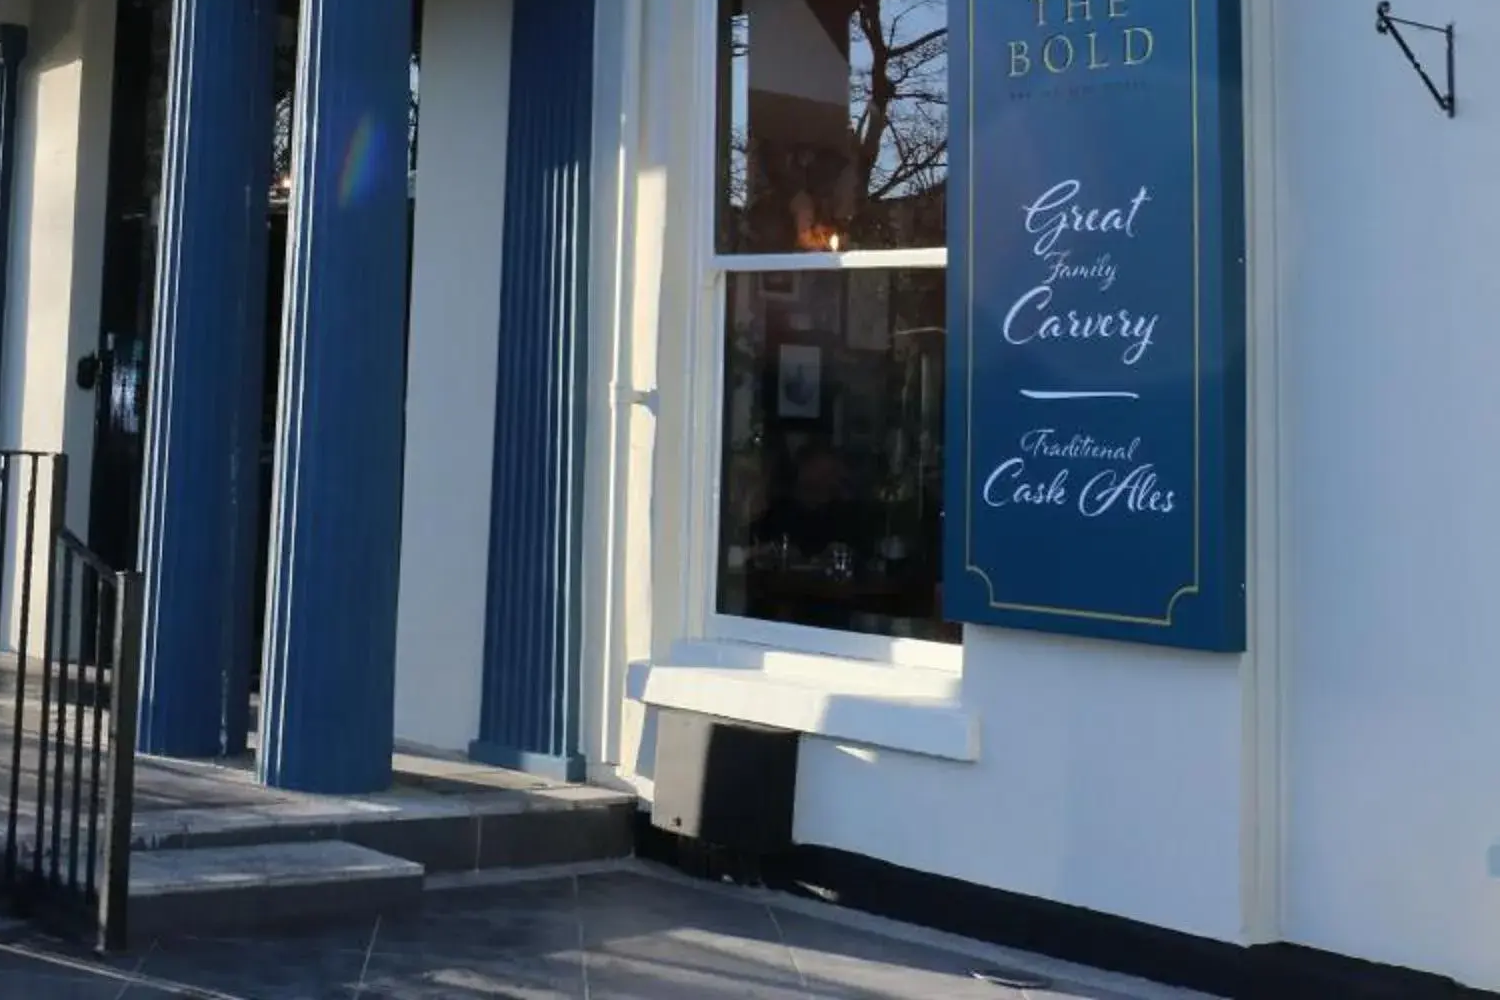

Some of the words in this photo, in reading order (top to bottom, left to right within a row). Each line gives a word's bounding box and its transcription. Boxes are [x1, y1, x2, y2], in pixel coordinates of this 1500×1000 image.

[1007, 27, 1154, 78] BOLD
[1022, 179, 1152, 256] Great
[1043, 250, 1118, 291] Family
[1003, 286, 1160, 366] Carvery
[1020, 428, 1141, 461] Traditional
[983, 457, 1070, 507] Cask
[1078, 463, 1175, 518] Ales
